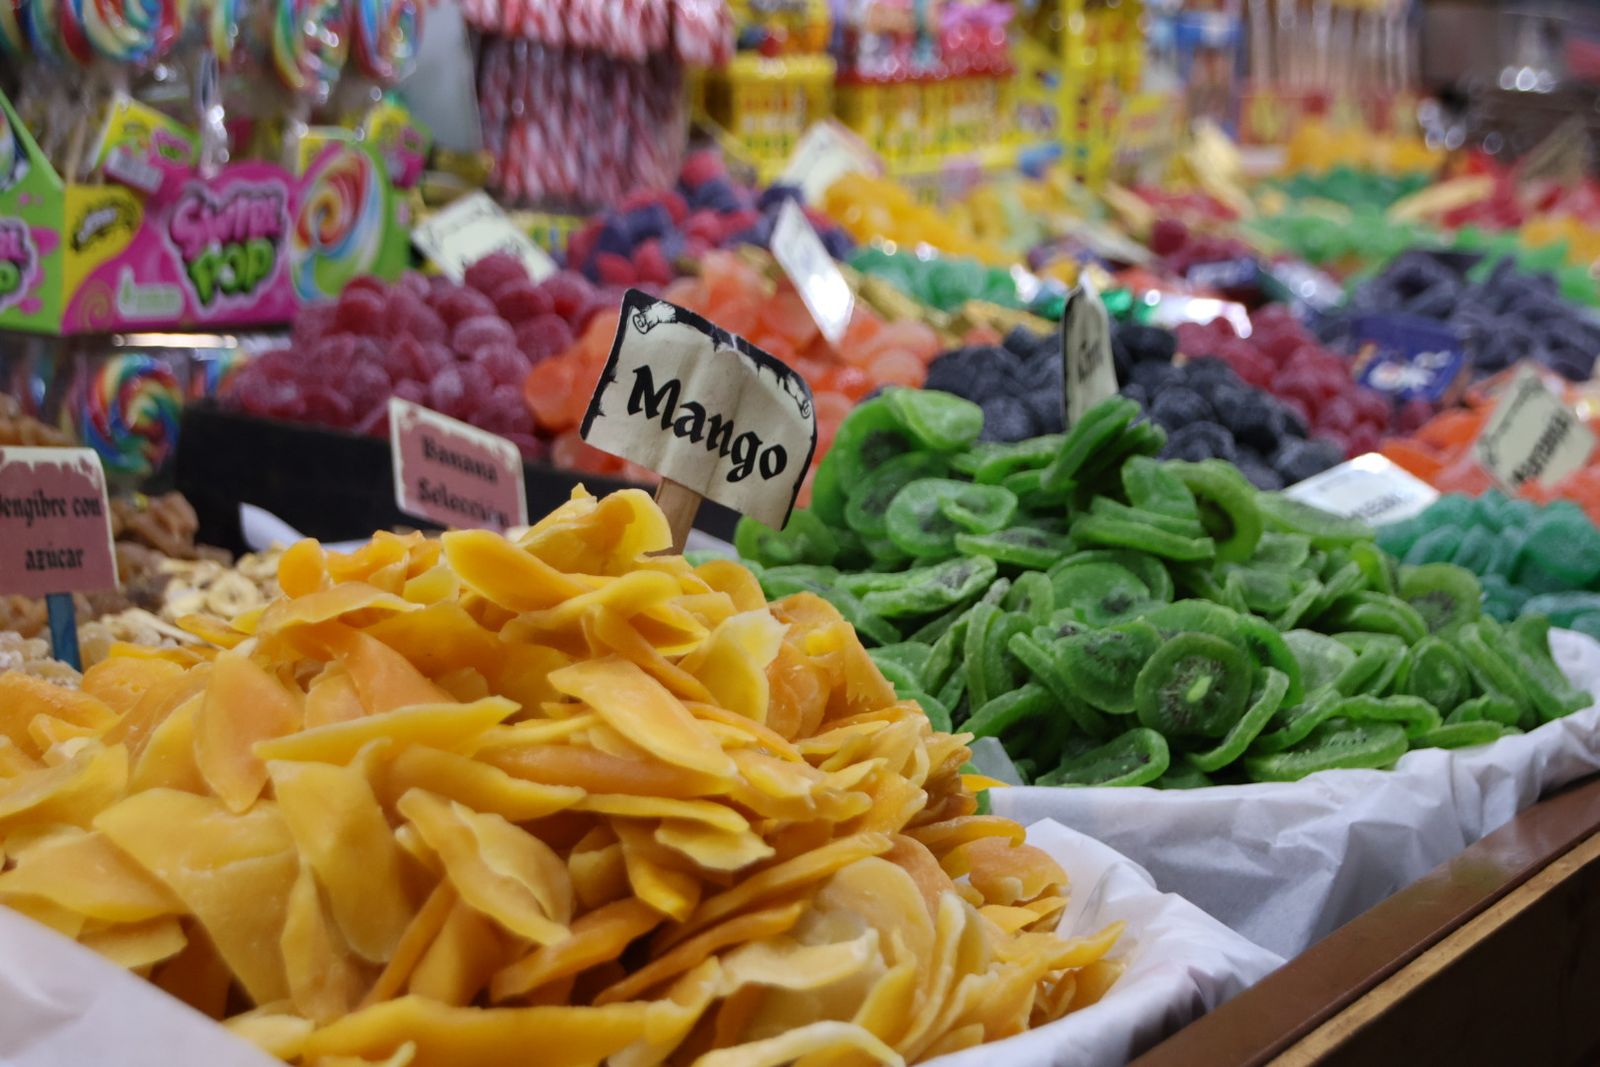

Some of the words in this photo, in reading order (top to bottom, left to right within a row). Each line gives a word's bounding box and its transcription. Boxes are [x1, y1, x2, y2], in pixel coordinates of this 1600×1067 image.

[627, 364, 787, 483] Mango
[422, 434, 498, 484] Banana
[73, 496, 102, 517] con
